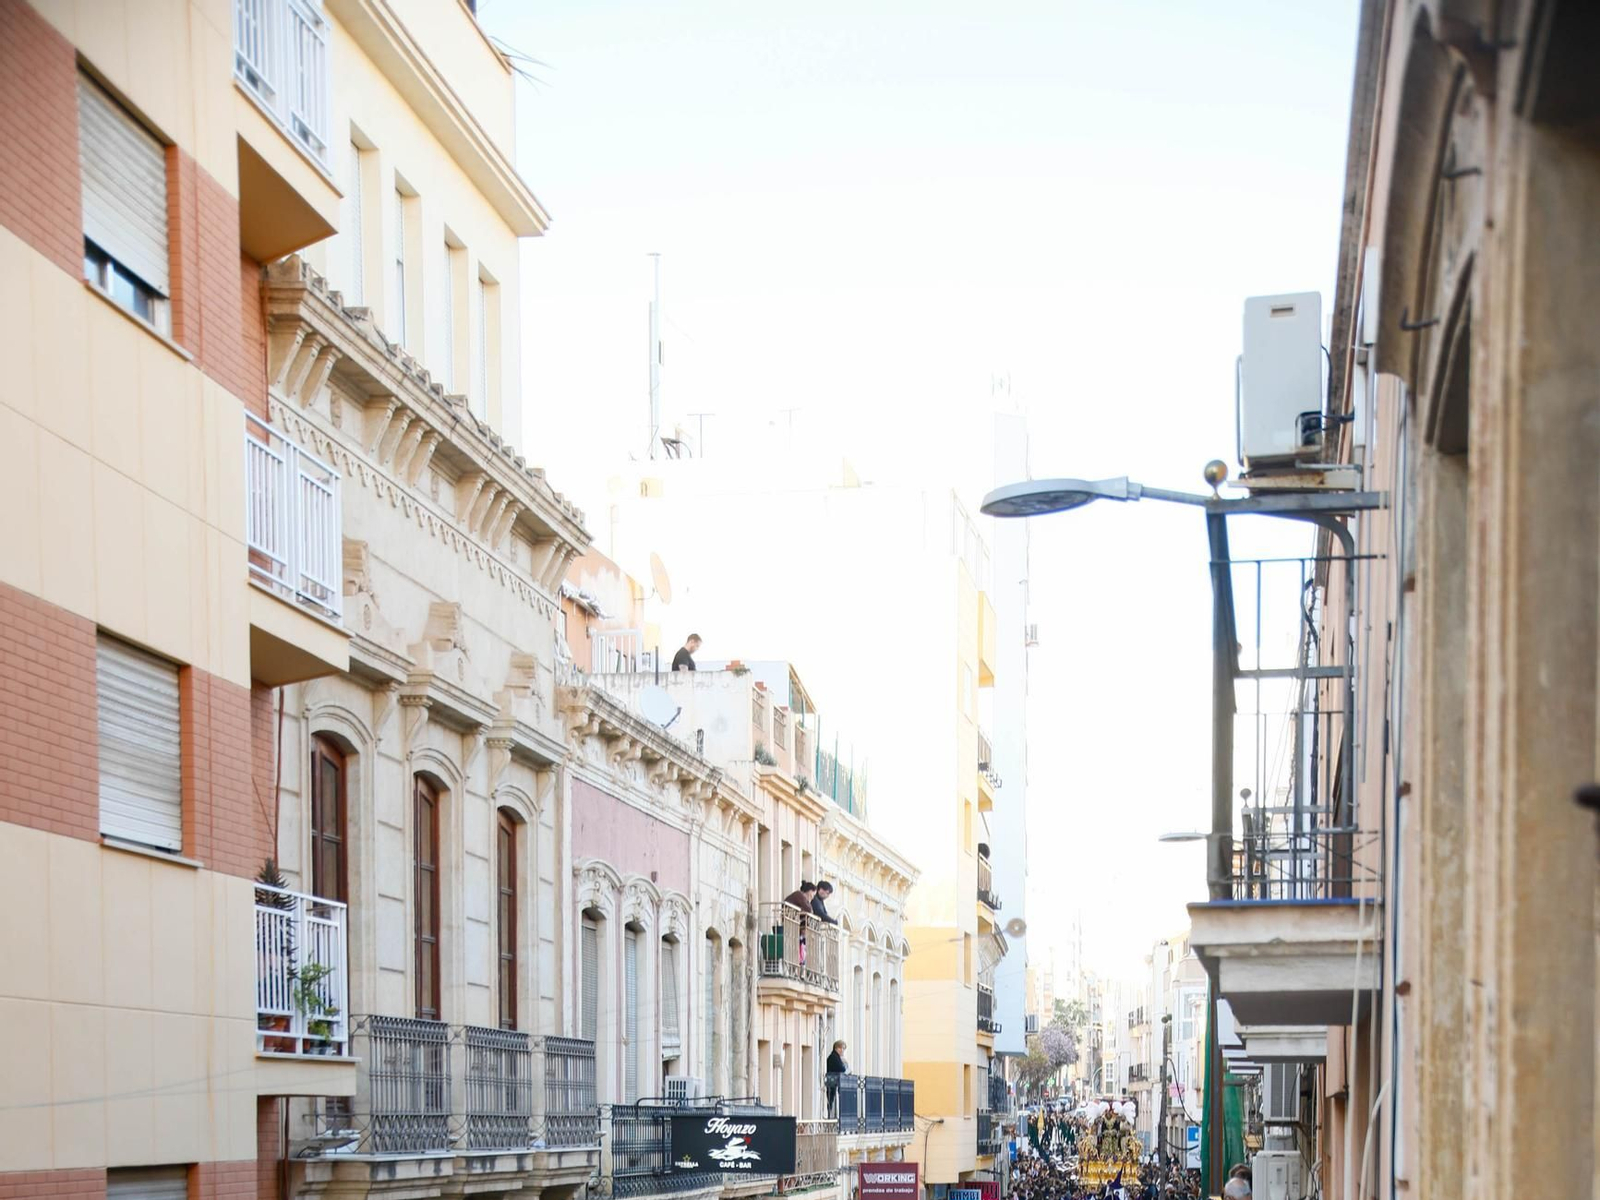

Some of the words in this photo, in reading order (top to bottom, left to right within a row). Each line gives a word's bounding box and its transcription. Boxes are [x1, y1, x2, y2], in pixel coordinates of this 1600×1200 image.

[704, 1118, 757, 1139] Hoyazo
[719, 1160, 735, 1169] CAFÉ
[863, 1173, 916, 1184] WORKING
[950, 1191, 979, 1200] BAMBI
